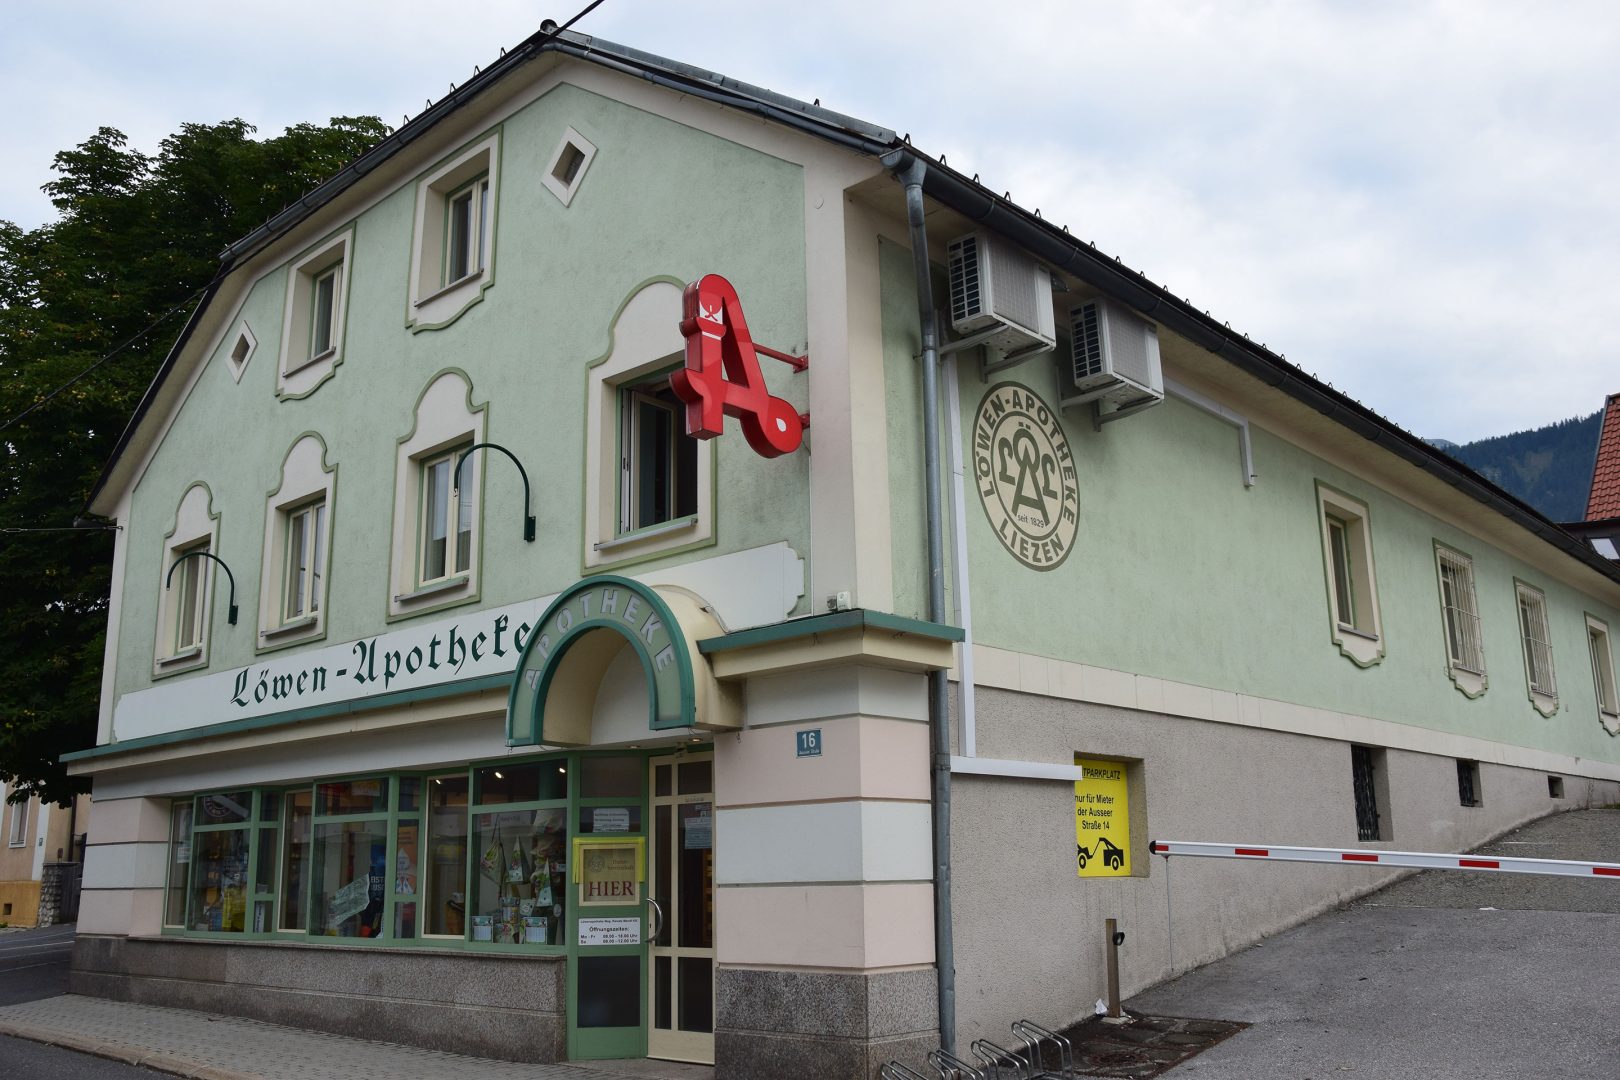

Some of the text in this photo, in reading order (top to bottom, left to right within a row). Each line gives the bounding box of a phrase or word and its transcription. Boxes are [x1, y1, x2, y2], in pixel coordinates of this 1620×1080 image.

[976, 389, 1076, 525] LÖWEN-APOTHEKE
[1017, 514, 1045, 528] seit 1829
[999, 518, 1065, 563] LIEZEN
[525, 588, 676, 690] APOTHEKE
[802, 732, 816, 748] 16
[1086, 794, 1095, 803] für
[1096, 794, 1114, 804] Mieter
[1077, 807, 1113, 817] der Ausseer
[1082, 820, 1110, 830] Straße 14
[588, 881, 635, 897] HIER
